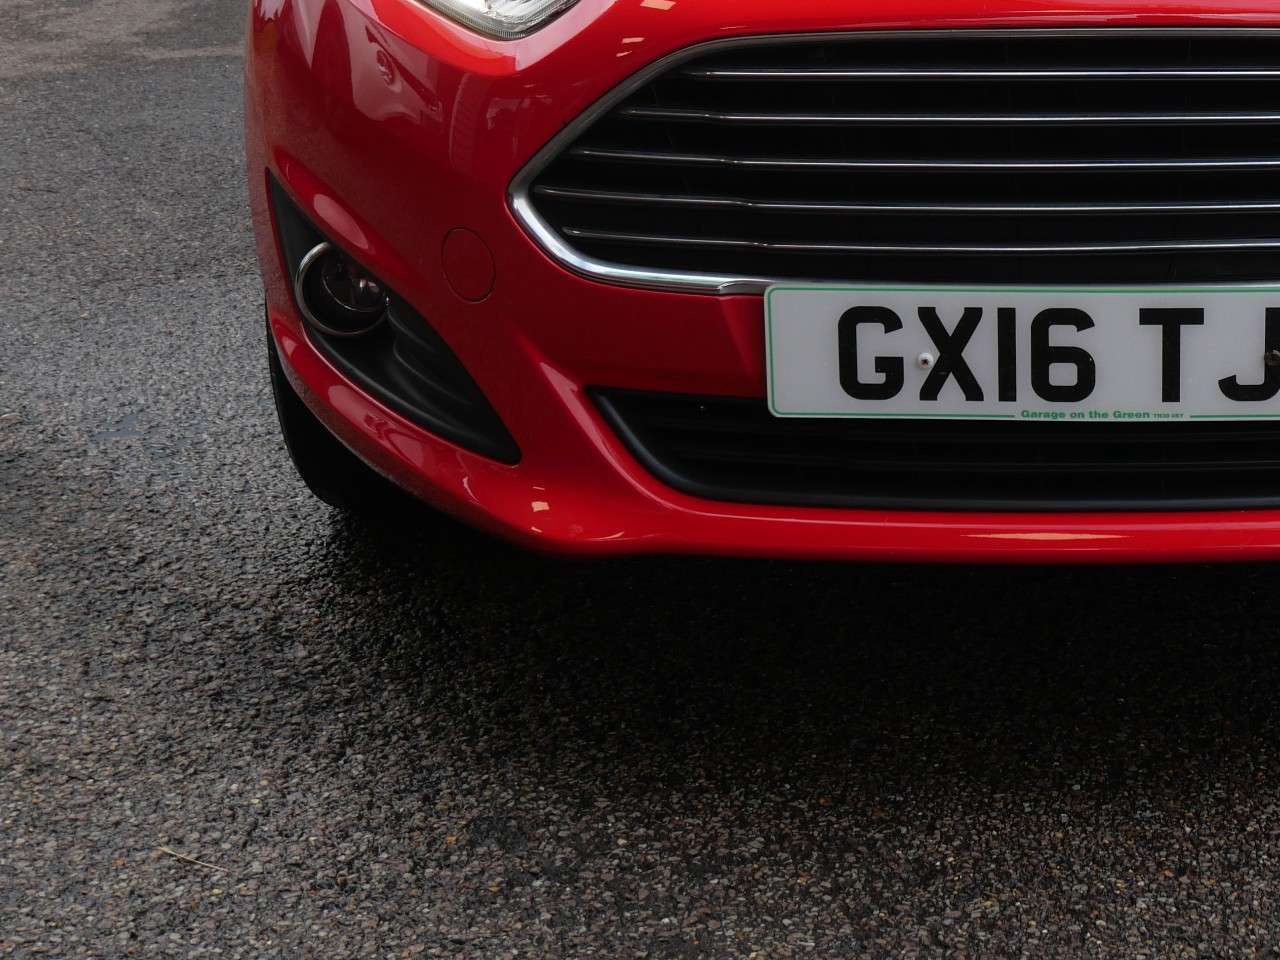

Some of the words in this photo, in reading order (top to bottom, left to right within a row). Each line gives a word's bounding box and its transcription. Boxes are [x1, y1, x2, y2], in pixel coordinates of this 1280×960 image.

[837, 305, 1096, 403] GX16
[1020, 409, 1066, 419] Garage
[1070, 411, 1085, 419] on
[1088, 410, 1109, 419] the
[1113, 410, 1150, 419] Green
